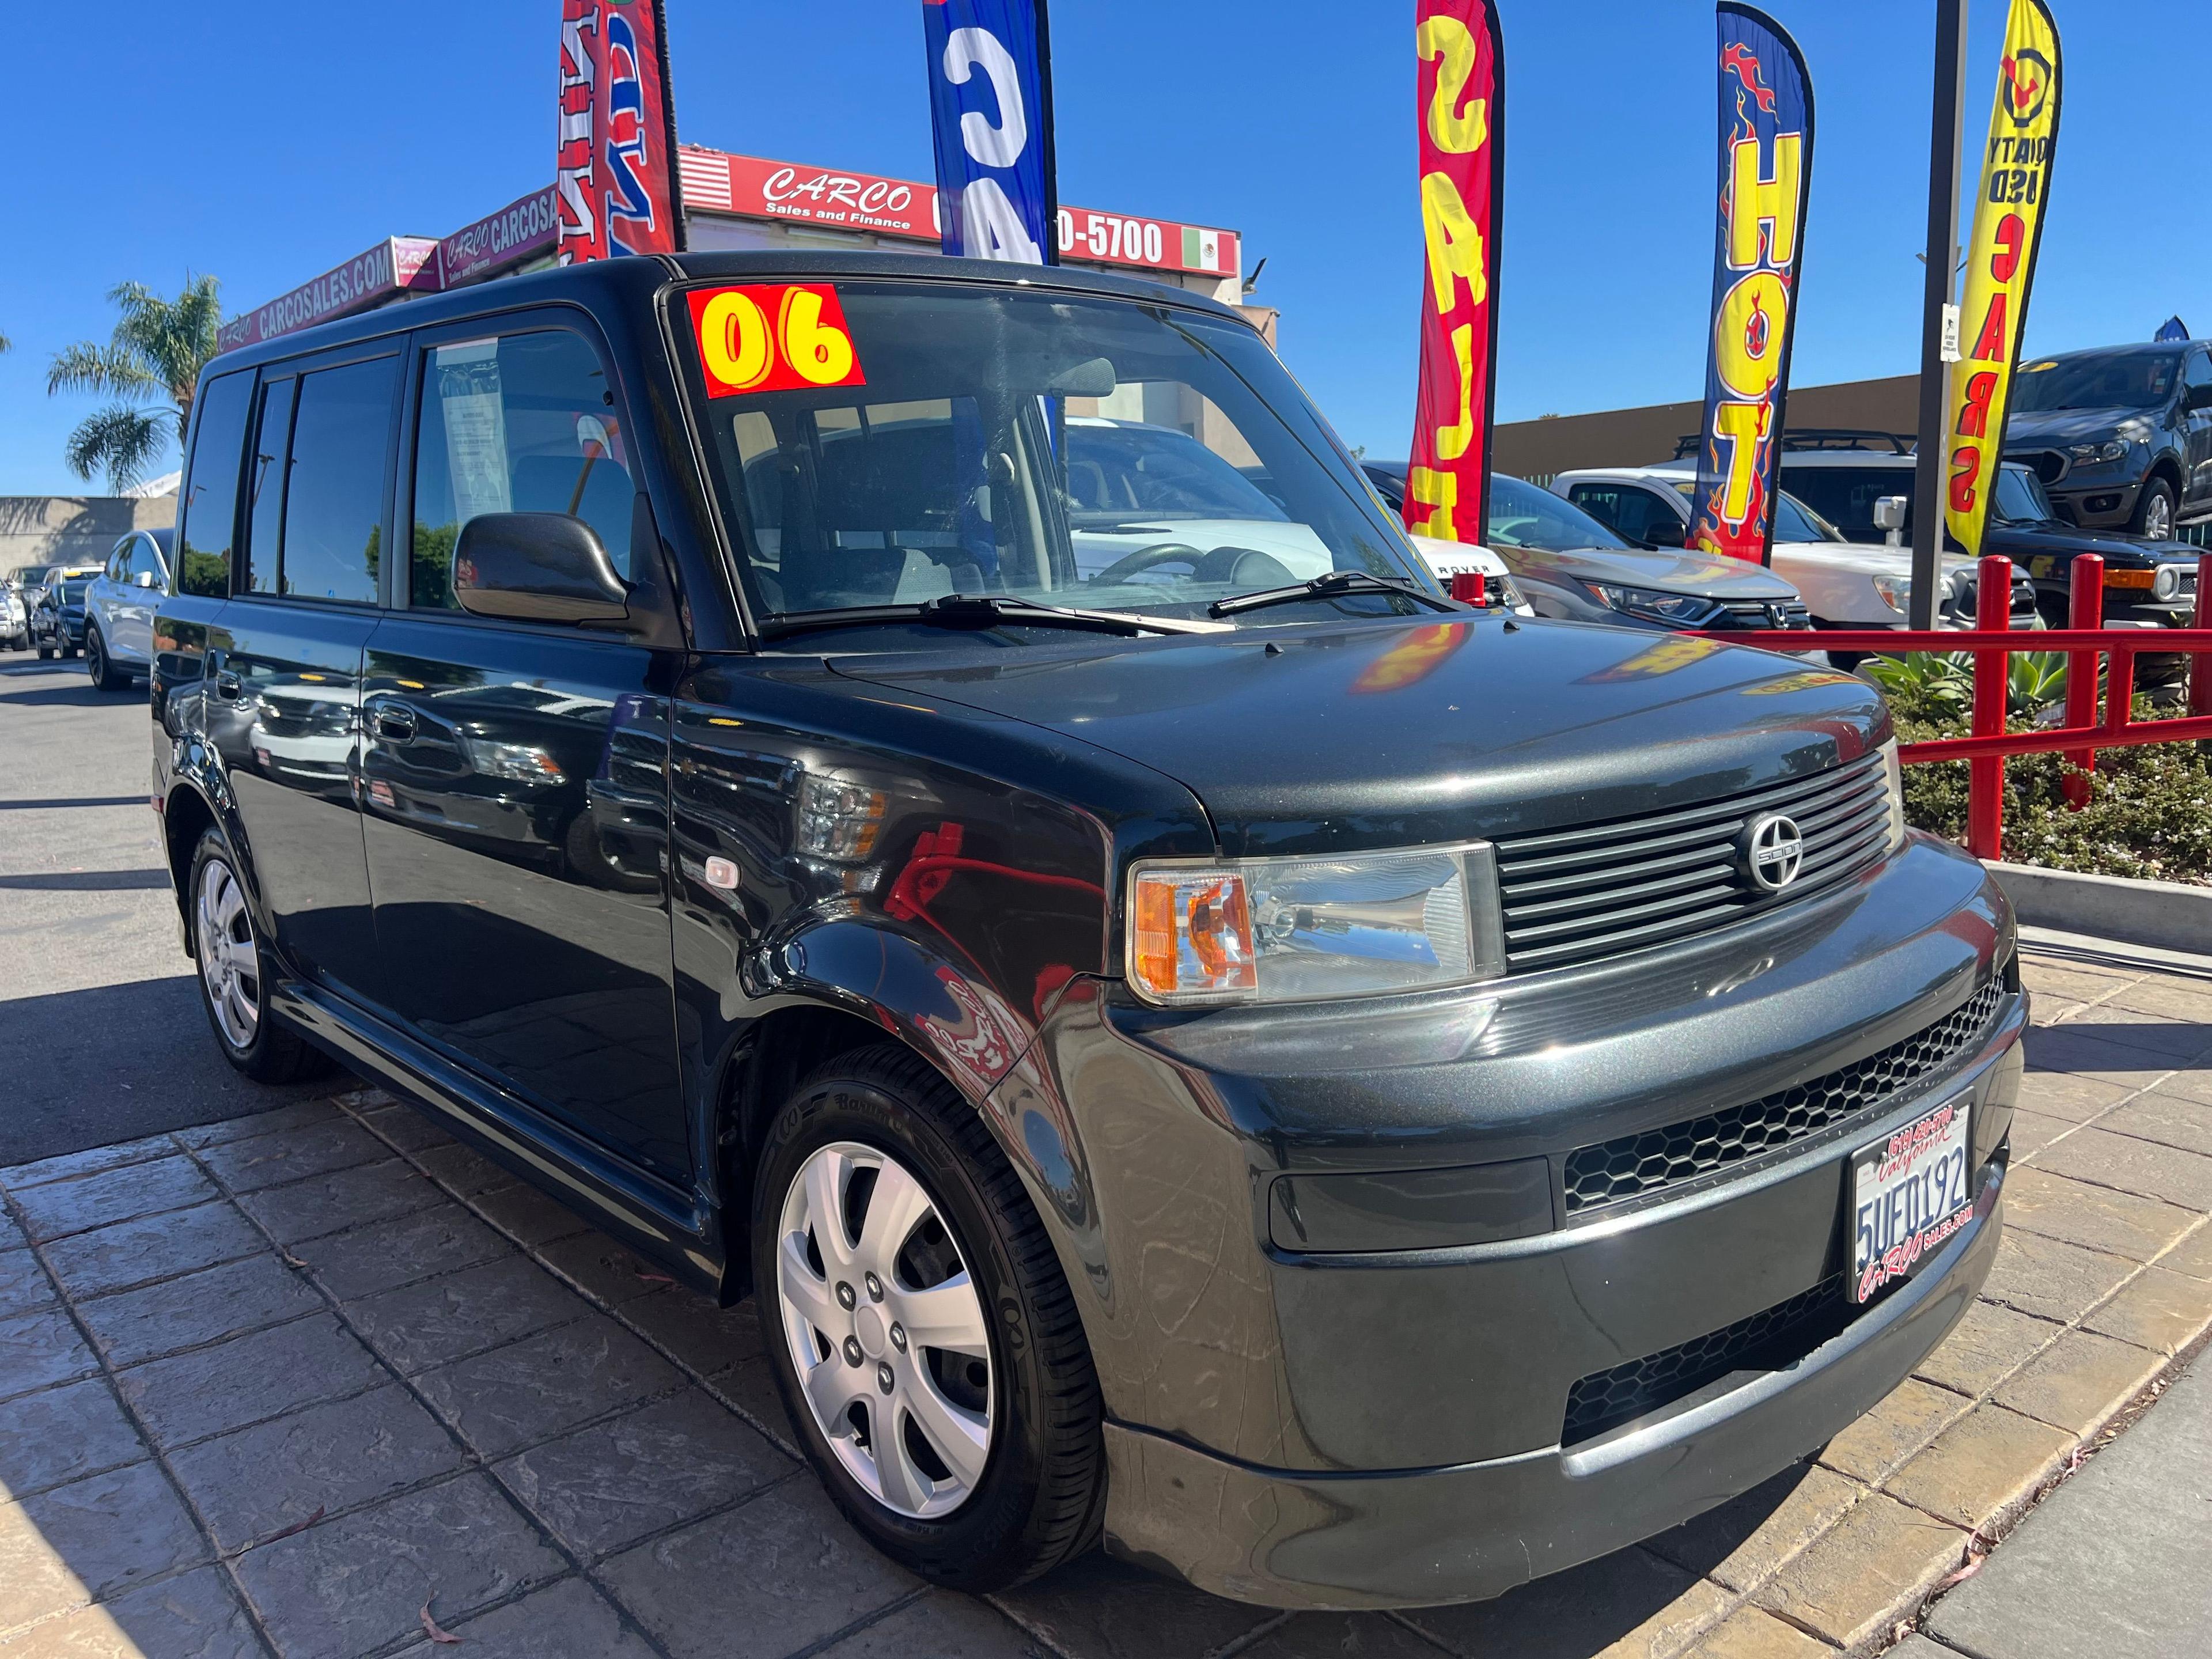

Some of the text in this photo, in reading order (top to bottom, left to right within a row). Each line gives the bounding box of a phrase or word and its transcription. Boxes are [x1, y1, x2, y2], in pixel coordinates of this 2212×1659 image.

[763, 168, 911, 213] CARCO
[765, 202, 911, 230] Sales and Finance
[446, 222, 489, 269] CARCO
[259, 244, 391, 340] CARCOSALES.COM
[701, 286, 853, 389] 06
[1715, 131, 1802, 525] HOT
[1438, 565, 1490, 574] ROVER
[1879, 1128, 1952, 1183] California
[1888, 1104, 1953, 1160] (619) 420-5700
[1857, 1144, 1964, 1267] 5UFD192
[1923, 1205, 1974, 1251] SALES.COM
